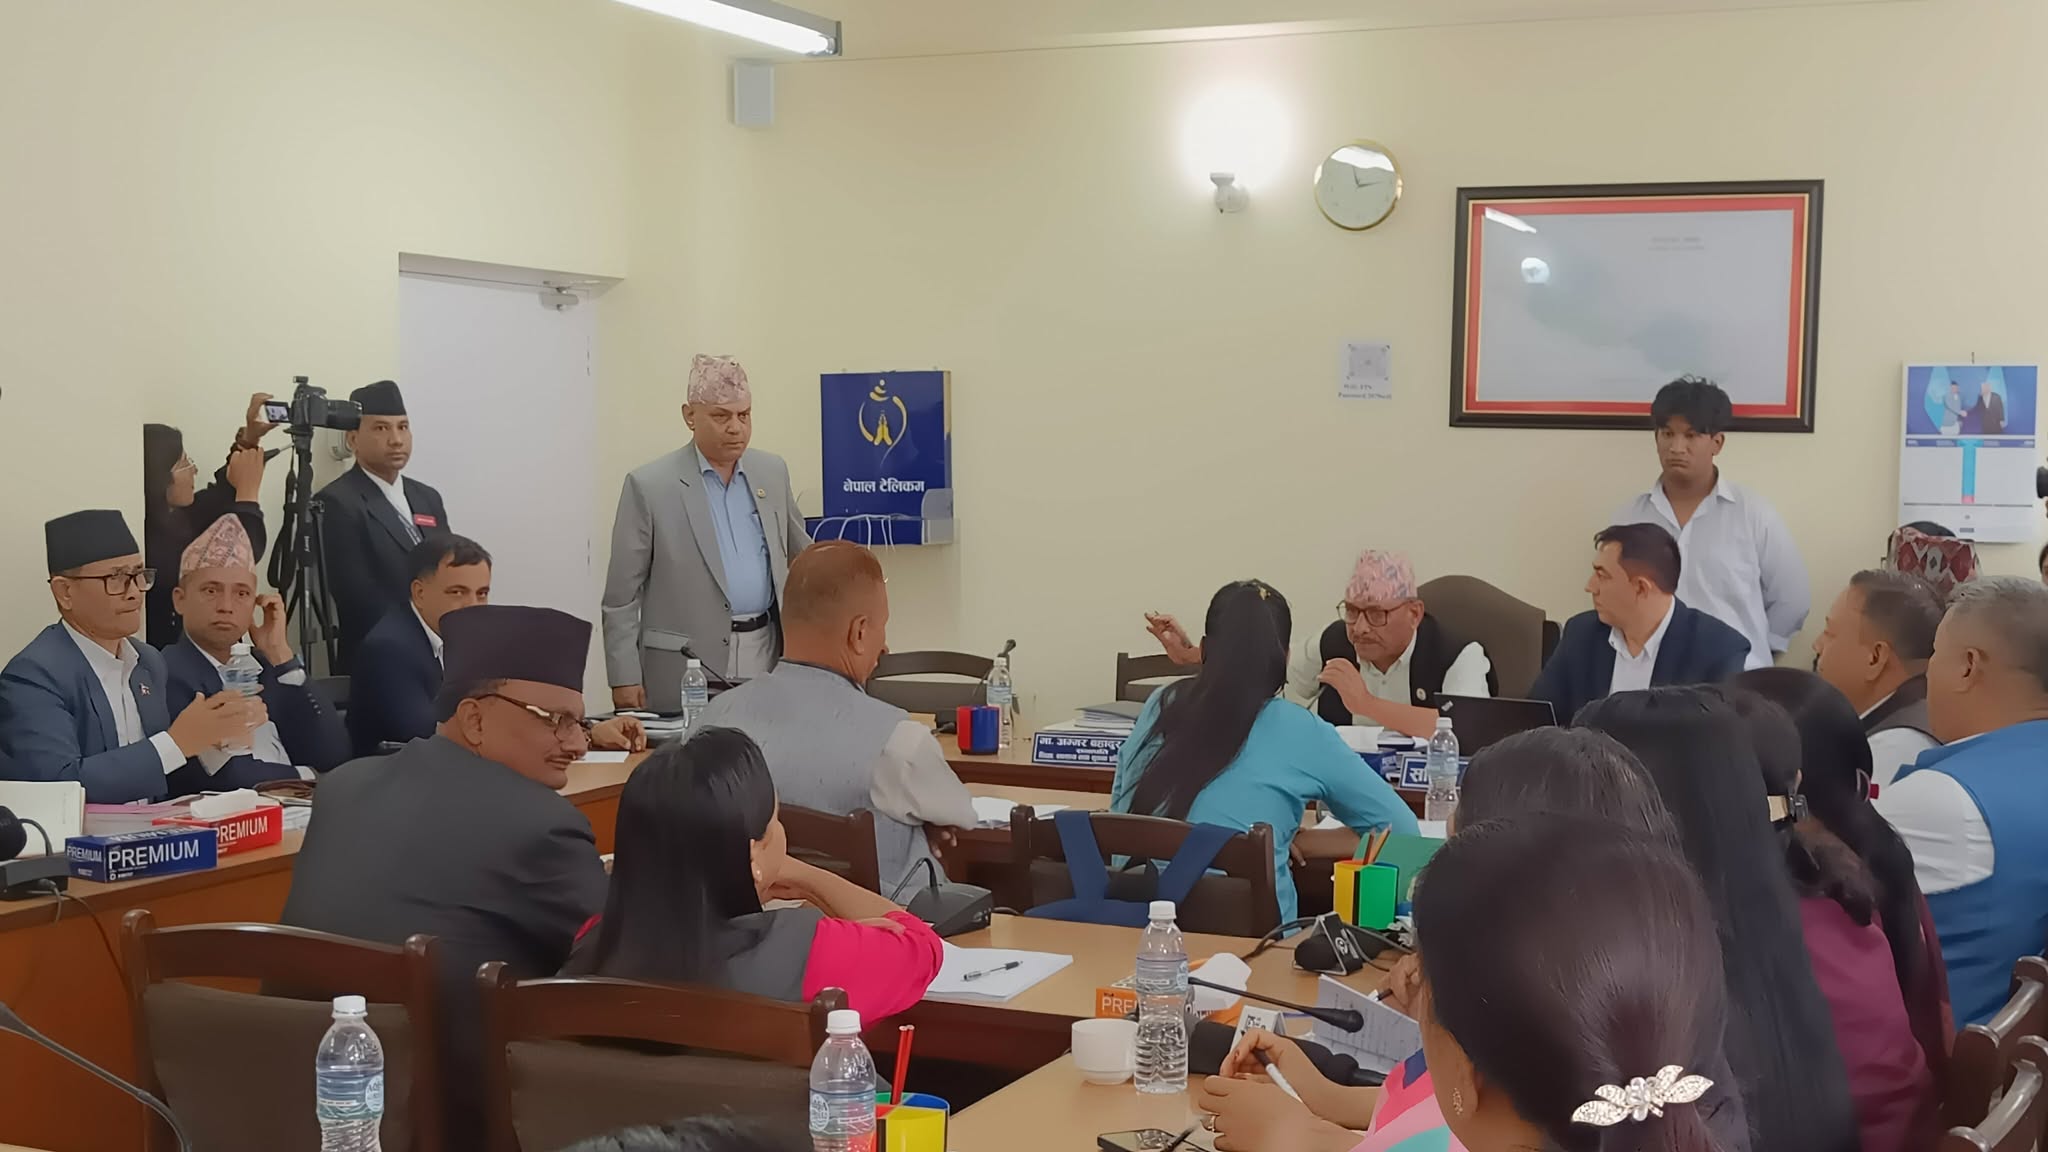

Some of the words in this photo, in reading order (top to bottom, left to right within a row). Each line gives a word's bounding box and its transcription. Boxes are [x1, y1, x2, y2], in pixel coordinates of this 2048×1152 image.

[843, 478, 876, 493] नेपाल
[880, 477, 925, 493] टेलिकम
[108, 839, 199, 870] PREMIUM
